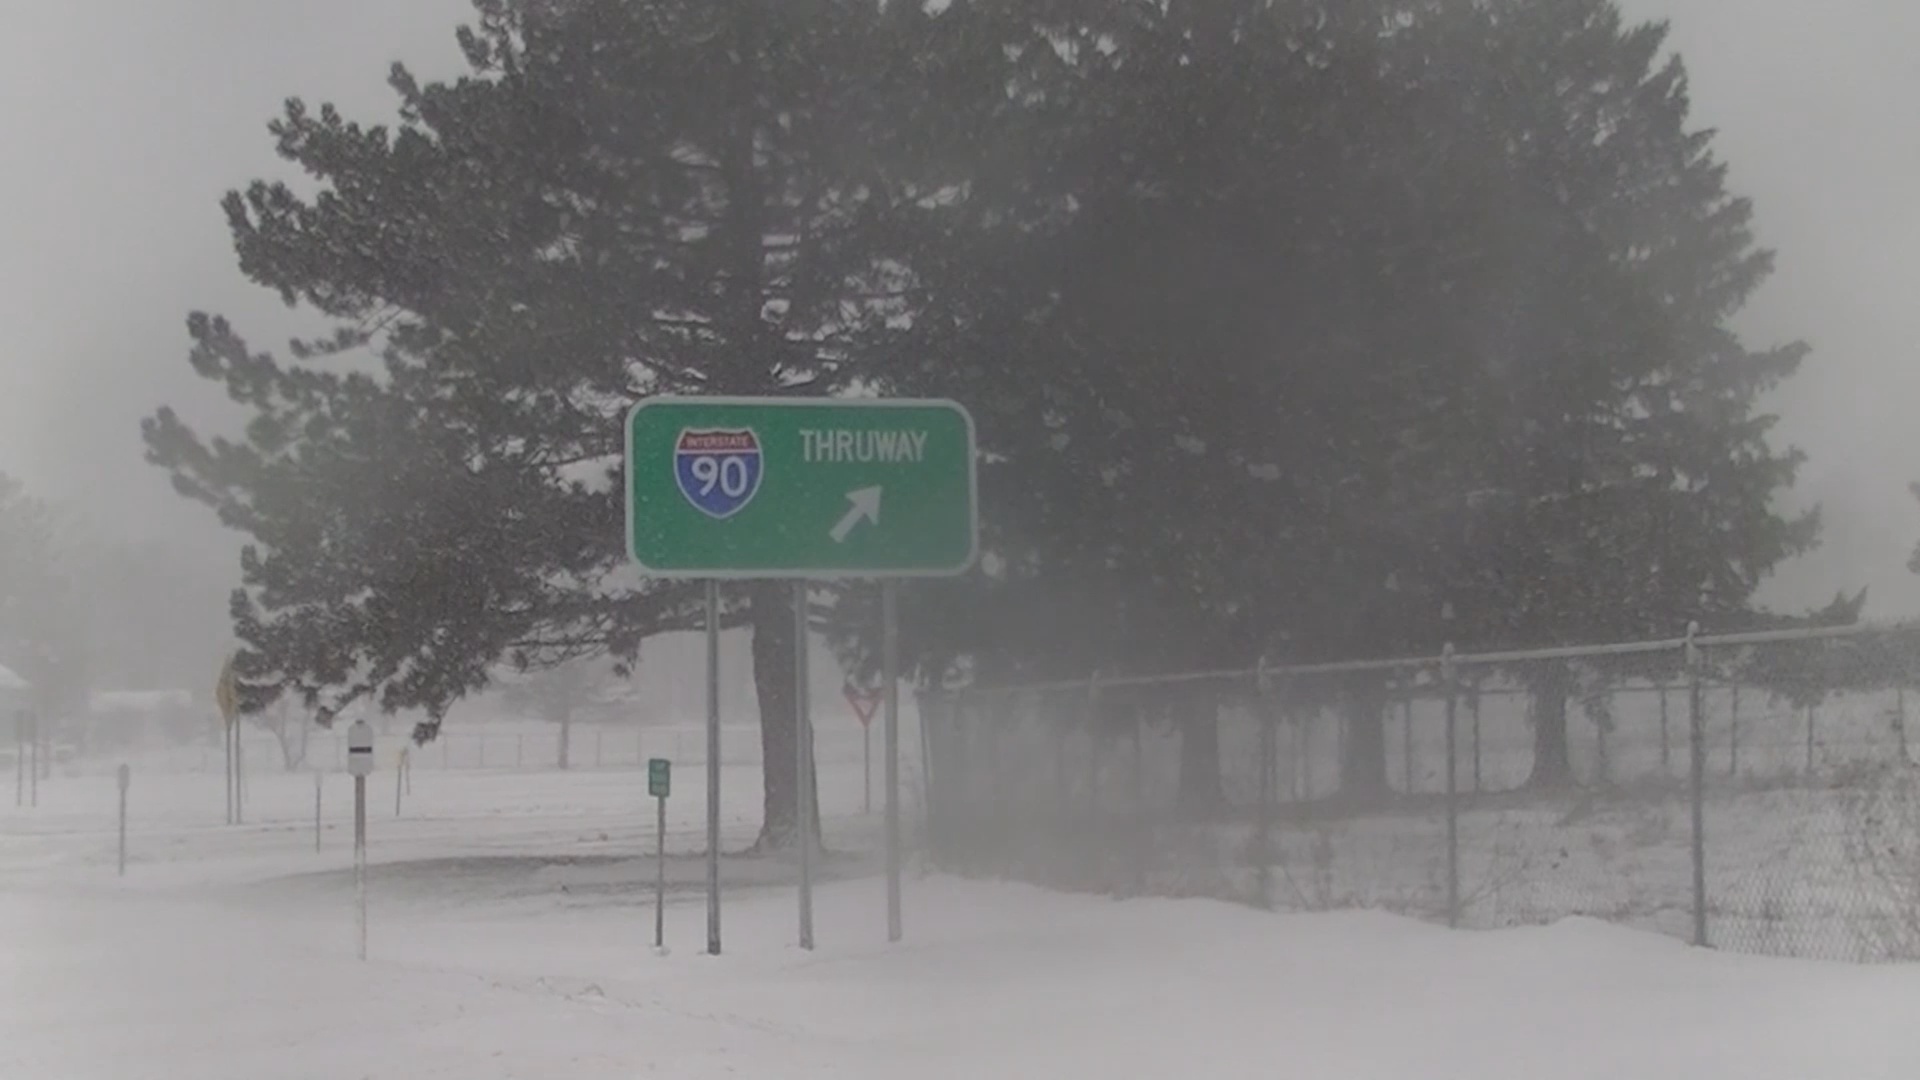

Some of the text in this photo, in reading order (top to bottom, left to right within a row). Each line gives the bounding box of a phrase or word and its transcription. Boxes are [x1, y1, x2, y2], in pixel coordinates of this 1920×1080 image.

[686, 436, 749, 449] INTERSTATE
[799, 429, 928, 463] THRUWAY
[691, 456, 748, 497] 90
